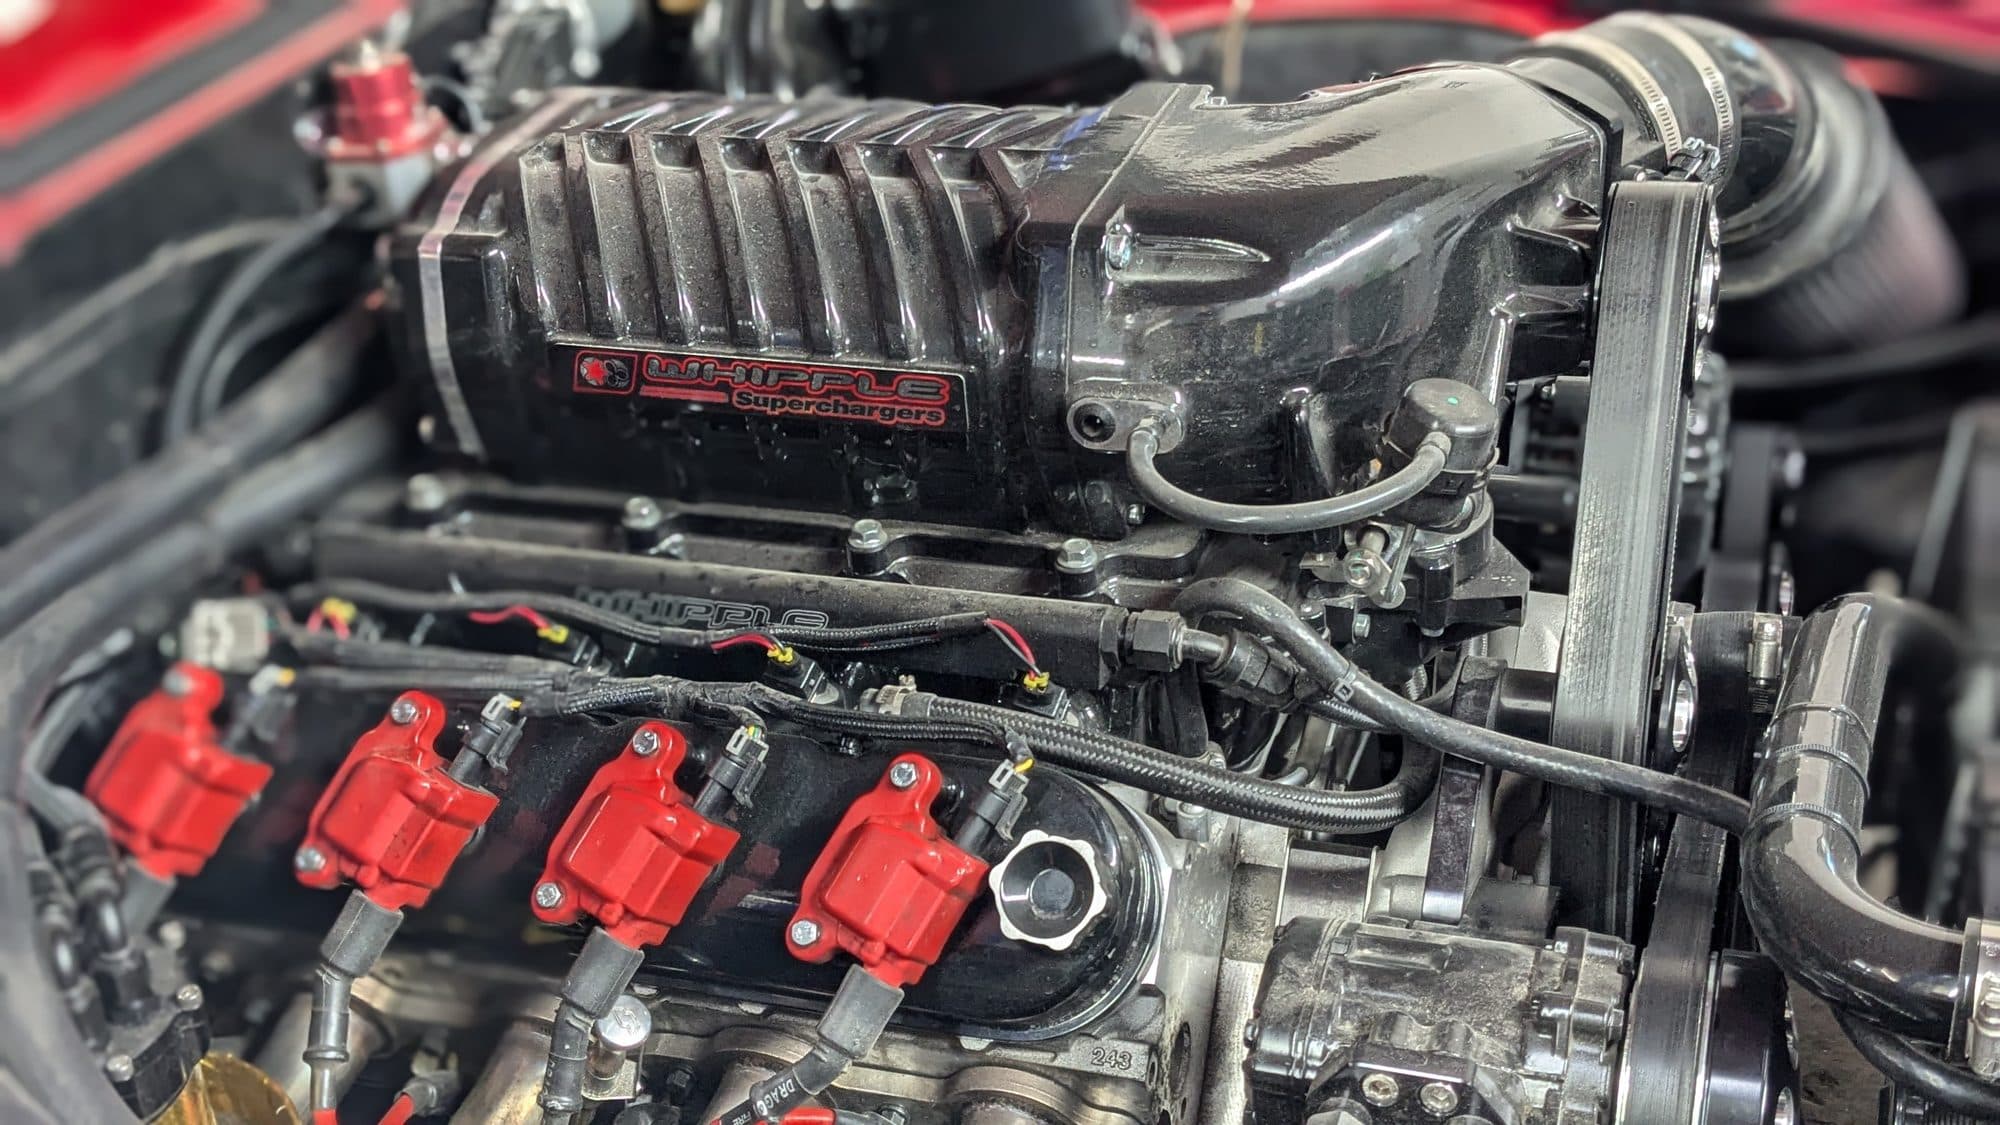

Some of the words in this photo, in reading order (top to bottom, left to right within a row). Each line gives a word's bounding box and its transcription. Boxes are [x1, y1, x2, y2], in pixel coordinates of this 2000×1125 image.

[645, 355, 949, 403] WHIPPLE
[735, 390, 945, 424] Superchargers
[1091, 1046, 1132, 1071] 243
